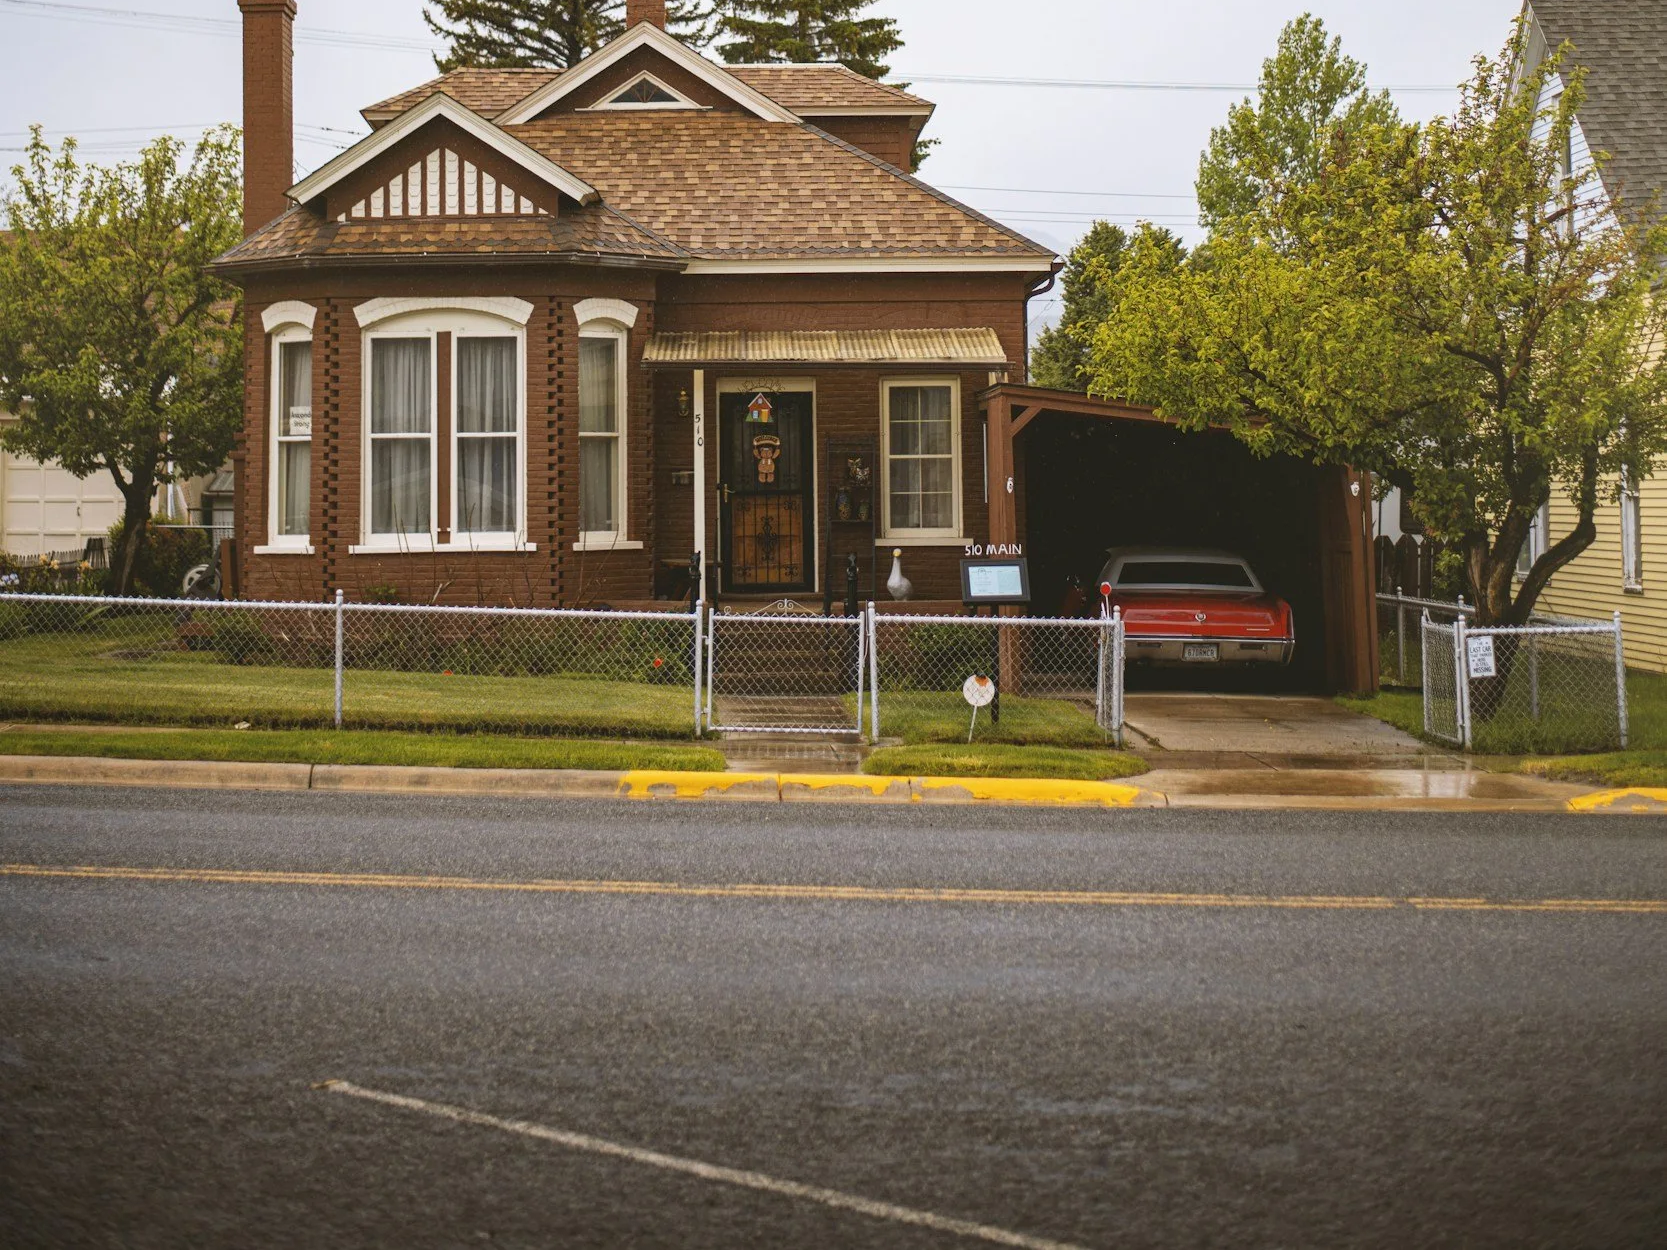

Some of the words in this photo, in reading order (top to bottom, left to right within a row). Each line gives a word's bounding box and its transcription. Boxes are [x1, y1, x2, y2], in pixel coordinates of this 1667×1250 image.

[694, 413, 704, 447] 510
[964, 544, 983, 556] 510
[985, 543, 1022, 556] MAIN
[1482, 645, 1492, 653] CAR
[1473, 666, 1492, 674] MISSING
